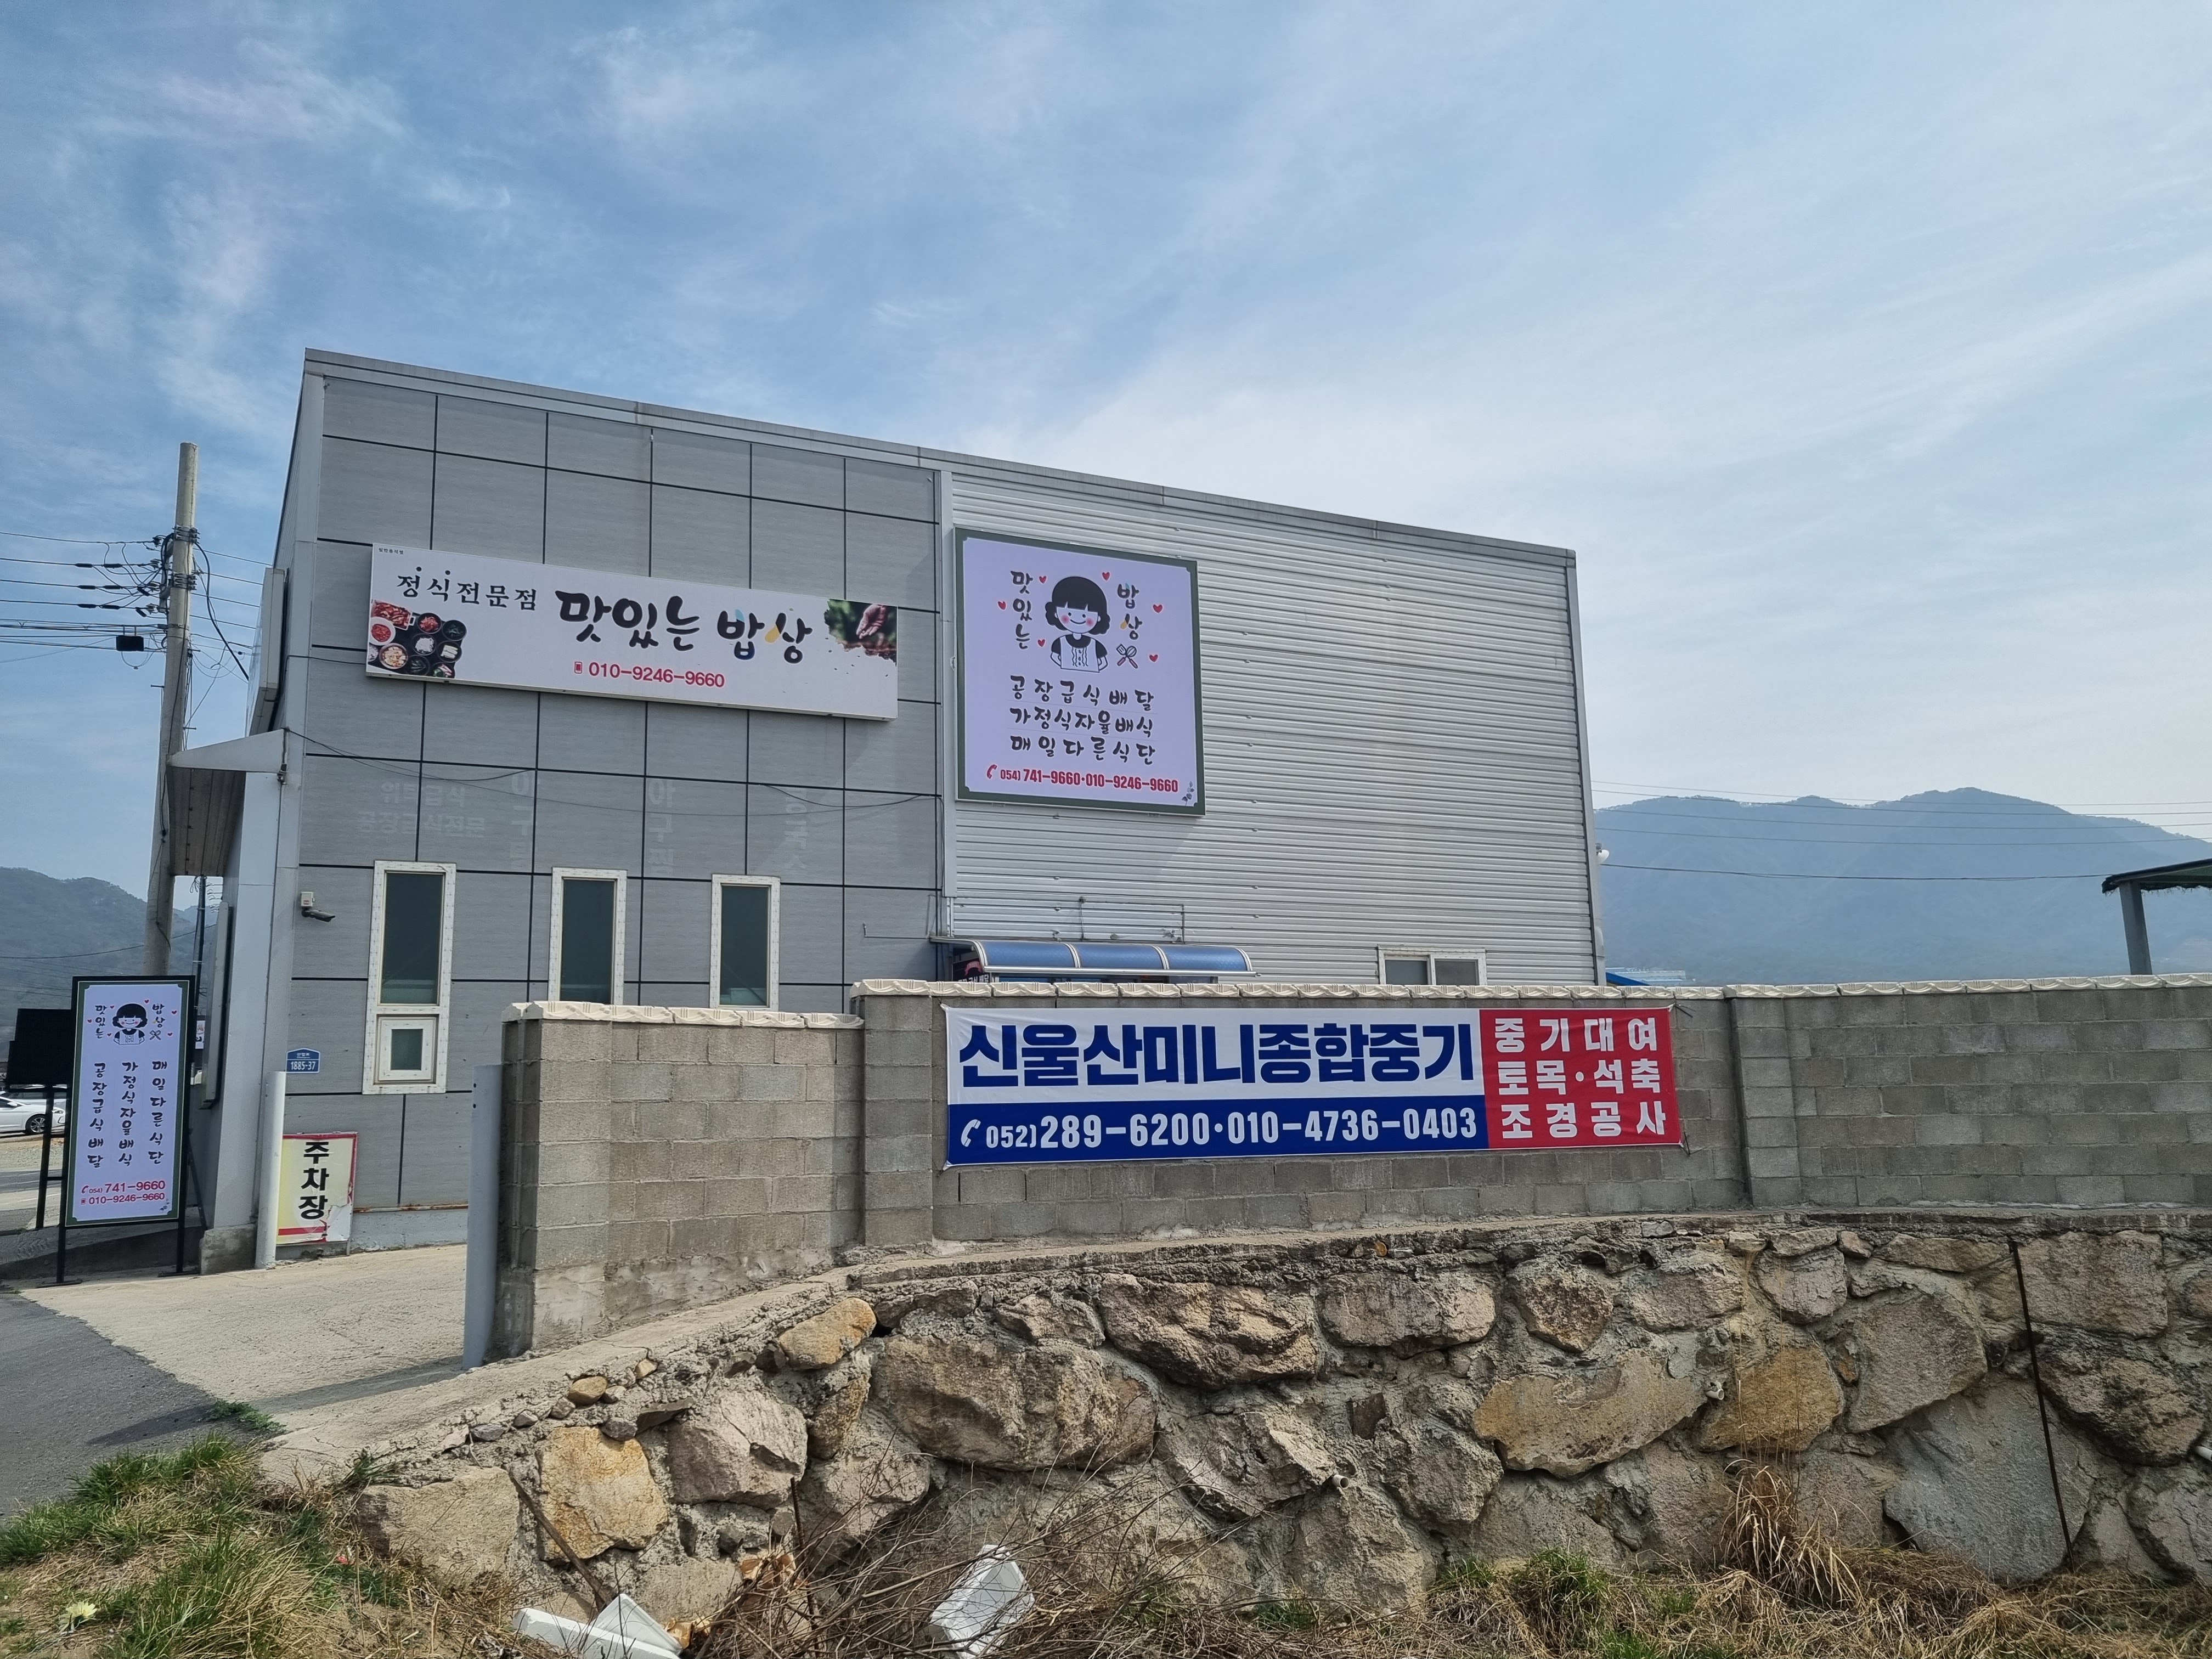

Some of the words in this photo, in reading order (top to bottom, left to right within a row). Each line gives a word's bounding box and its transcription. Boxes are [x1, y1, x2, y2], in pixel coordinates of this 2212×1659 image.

[397, 566, 537, 611] 정식전문점
[554, 590, 700, 652] 맛있는
[717, 609, 813, 664] 밥상
[1010, 571, 1034, 650] 맛있는
[1118, 583, 1142, 640] 밥상
[589, 662, 725, 688] 010-9246-9660
[95, 1005, 107, 1039] 맛있는
[152, 1003, 165, 1029] 밥상
[291, 1061, 316, 1070] 1885-37
[959, 1023, 1474, 1087] 신울산미니종합중기
[89, 1193, 165, 1205] 010-9246-9660
[298, 1142, 329, 1220] 주차장
